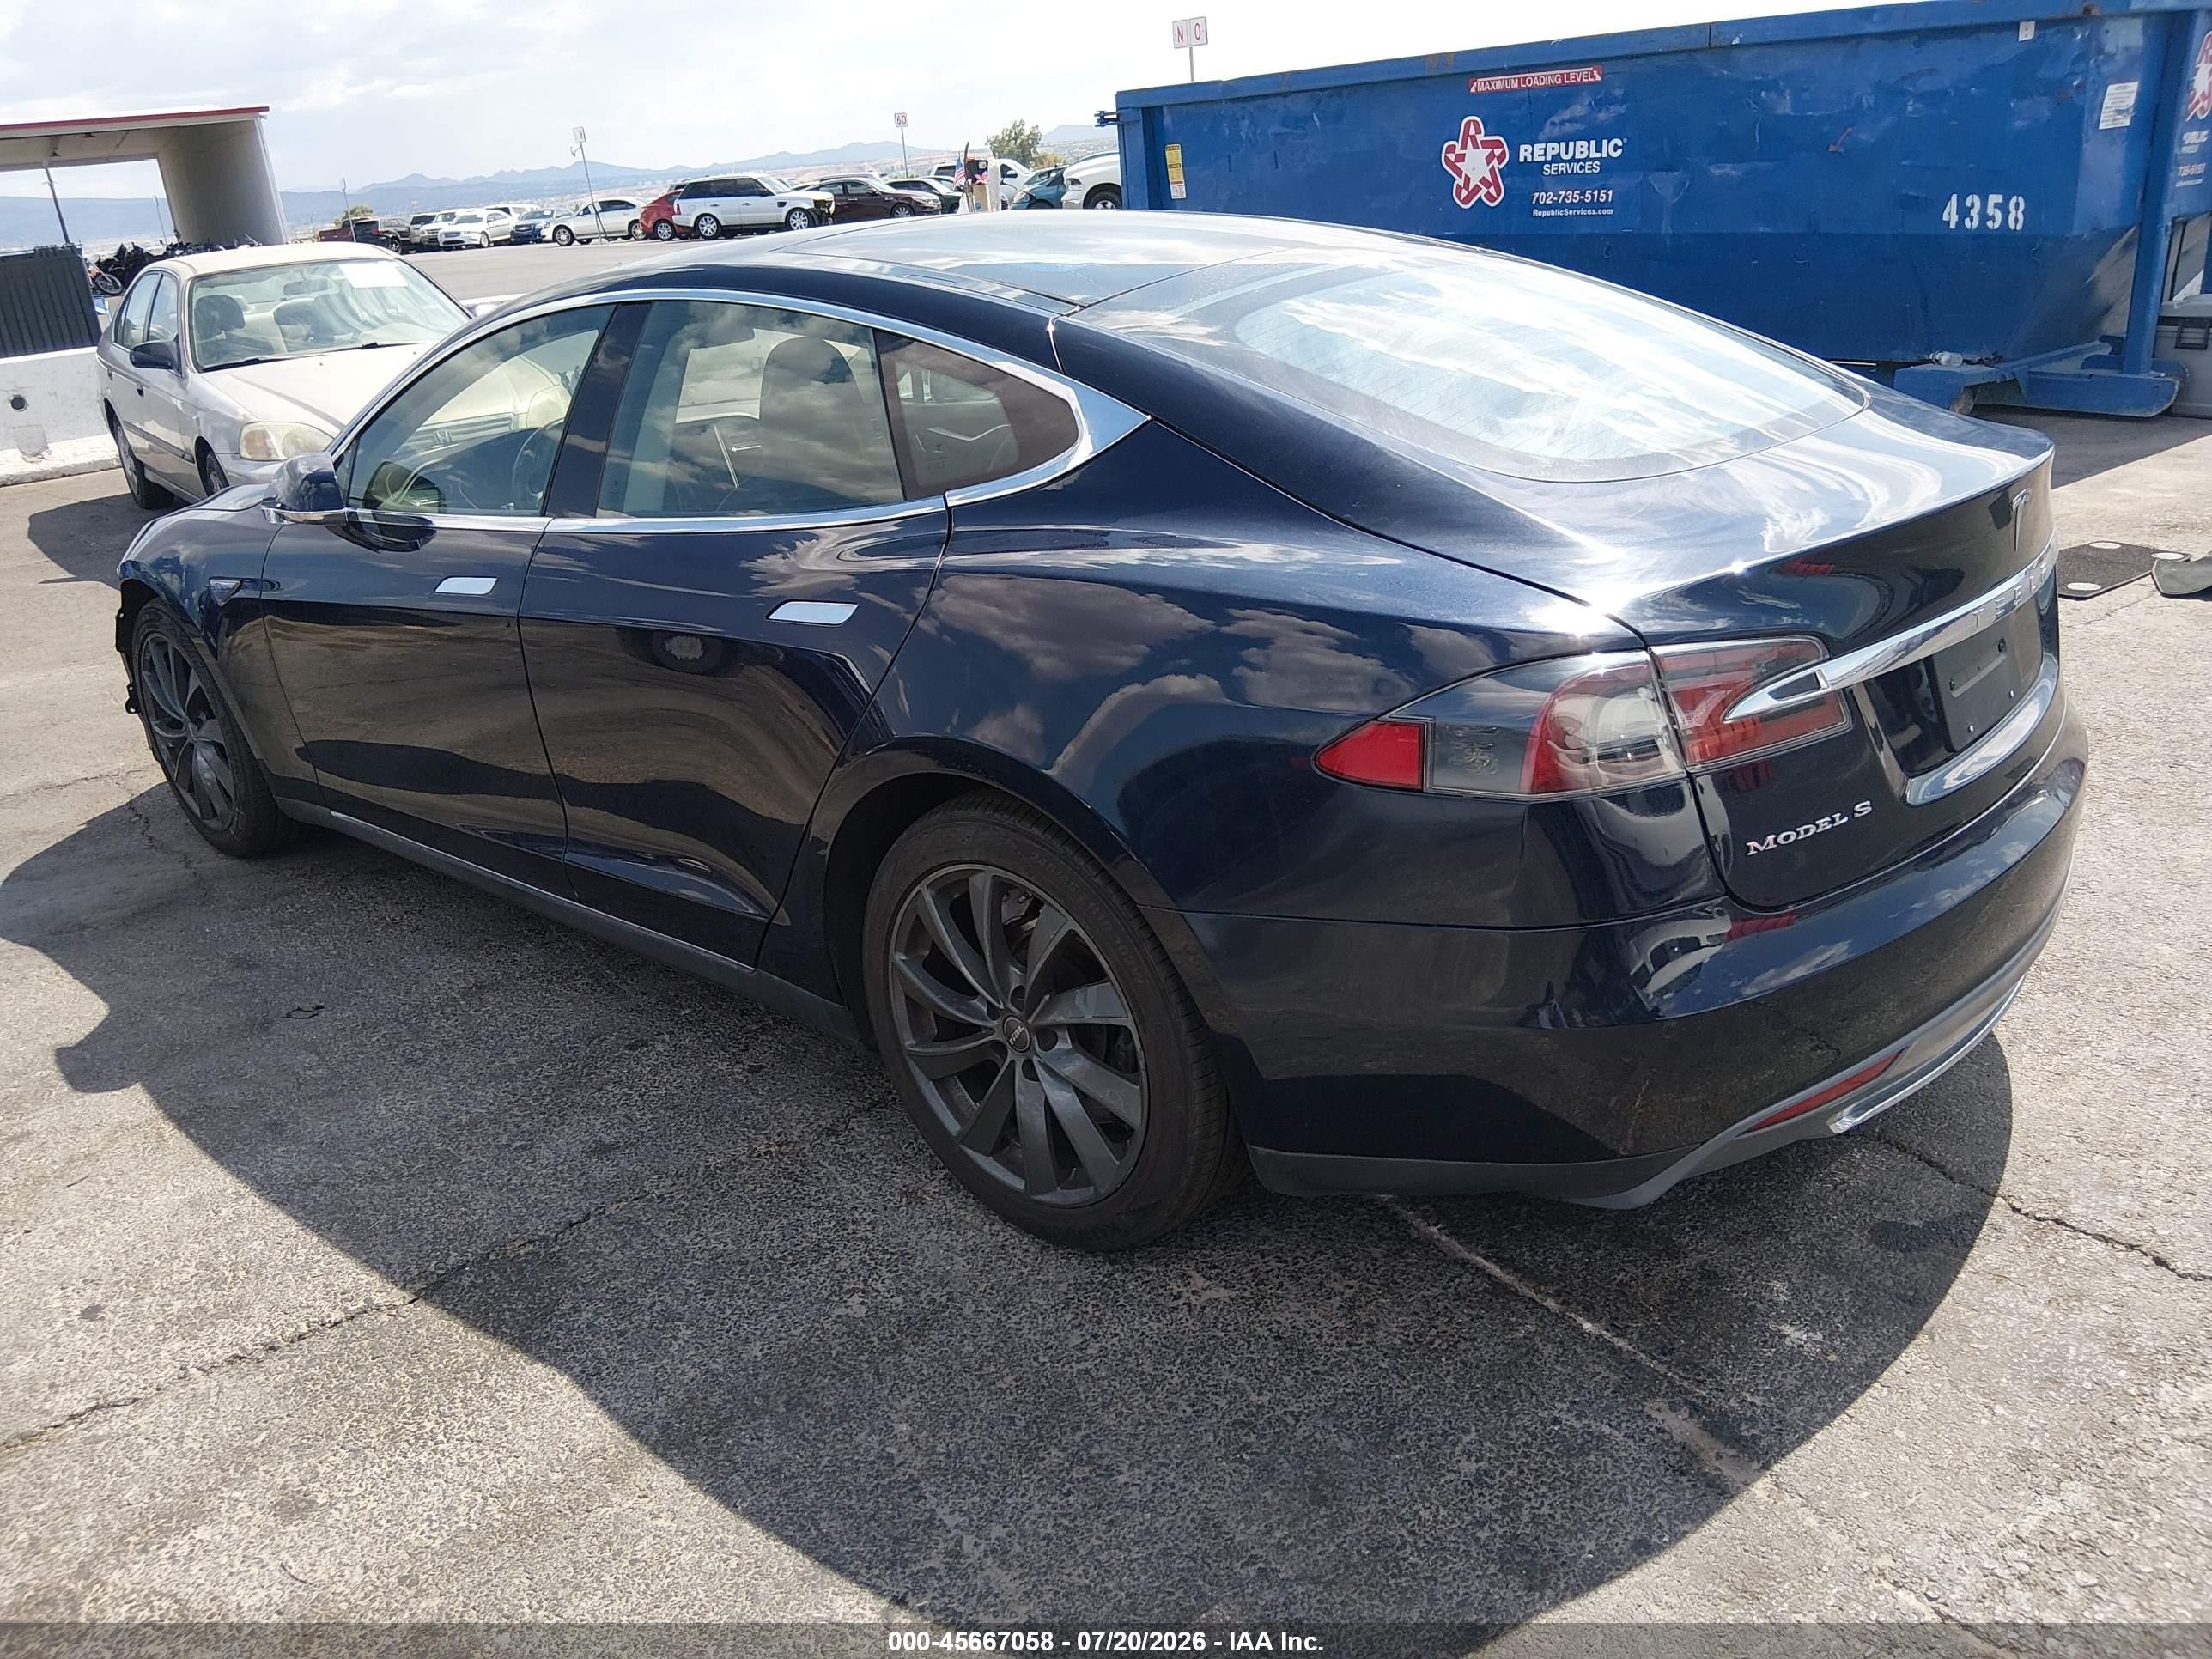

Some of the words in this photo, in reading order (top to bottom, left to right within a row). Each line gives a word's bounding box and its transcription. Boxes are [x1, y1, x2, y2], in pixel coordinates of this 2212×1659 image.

[1477, 78, 1519, 92] MAXIMUM
[1520, 74, 1561, 88] LOADING
[1564, 70, 1595, 83] LEVEL
[1518, 137, 1623, 162] REPUBLIC
[1542, 161, 1601, 176] SERVICES
[1532, 189, 1613, 204] 702-735-5151
[1532, 207, 1613, 218] RepublicServices.com
[1942, 193, 2025, 231] 4358
[1745, 812, 1849, 856] MODEL
[1853, 800, 1873, 818] S
